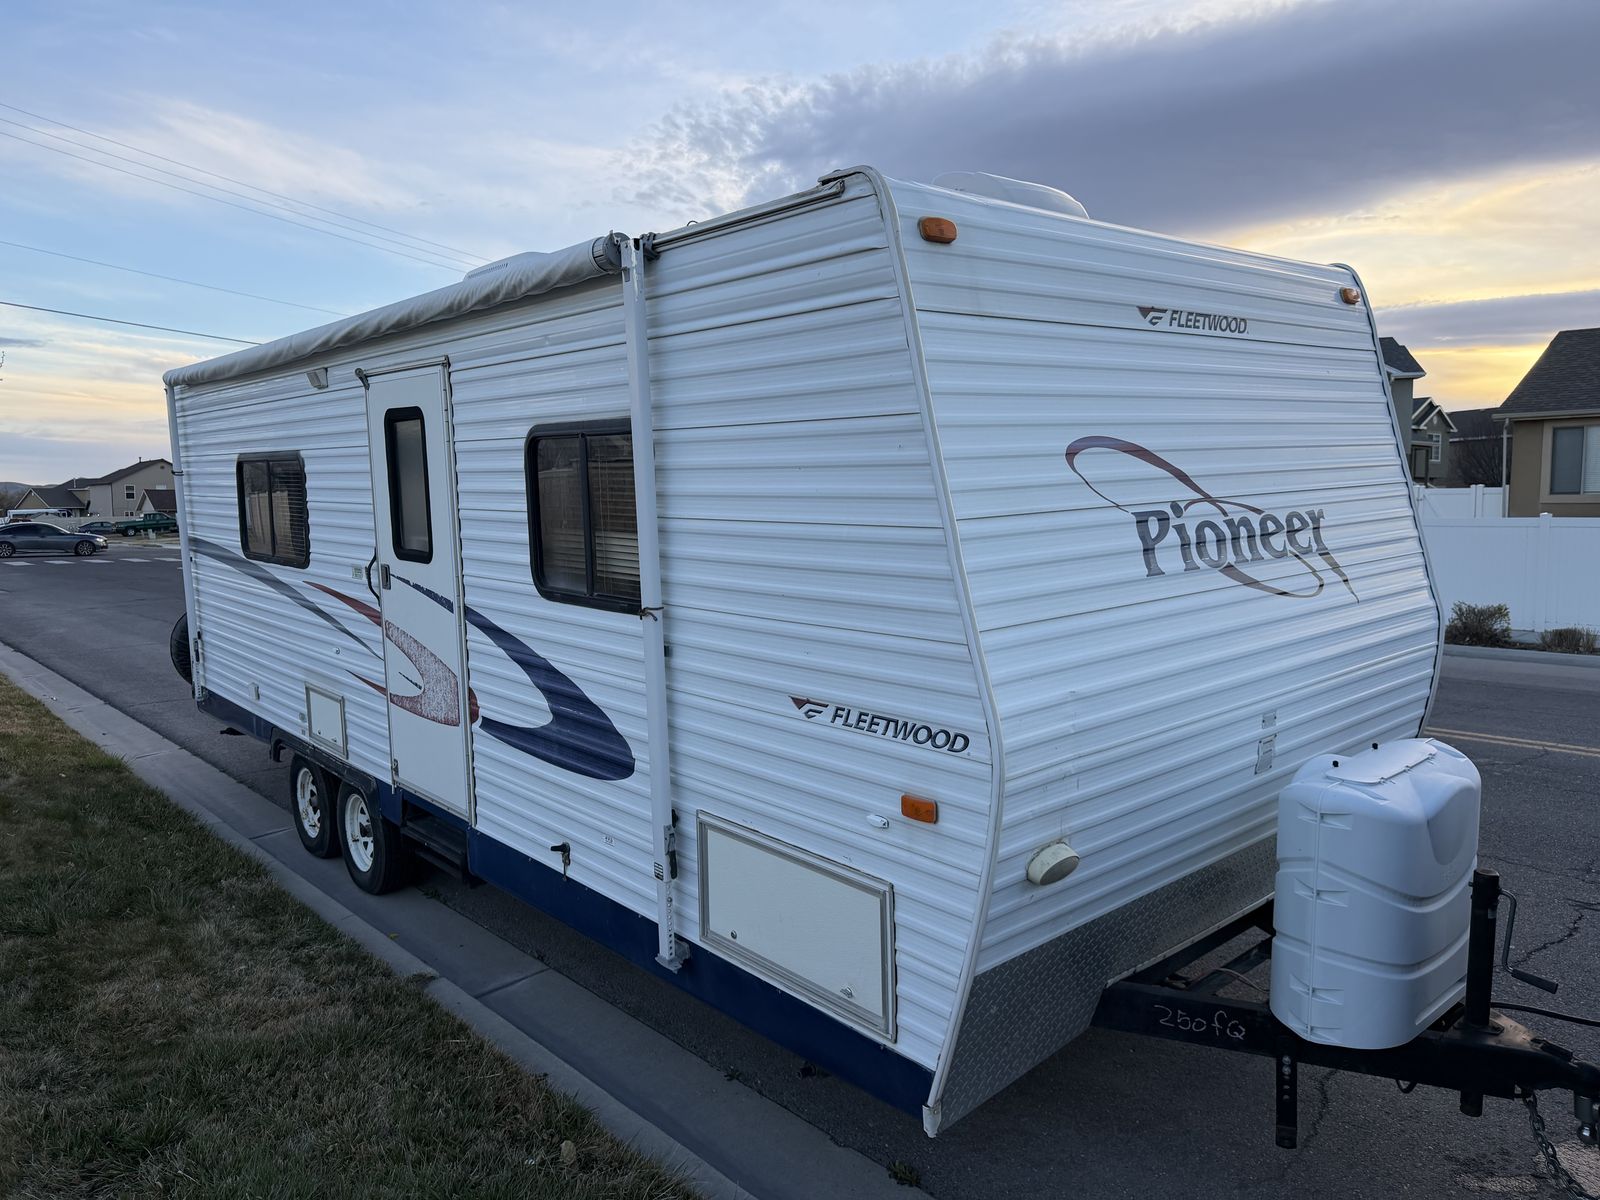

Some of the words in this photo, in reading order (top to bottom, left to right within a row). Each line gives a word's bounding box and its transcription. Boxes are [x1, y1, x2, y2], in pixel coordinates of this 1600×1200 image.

[1169, 310, 1247, 334] FLEETWOOD
[1131, 501, 1325, 577] Pioneer
[830, 705, 970, 753] FLEETWOOD
